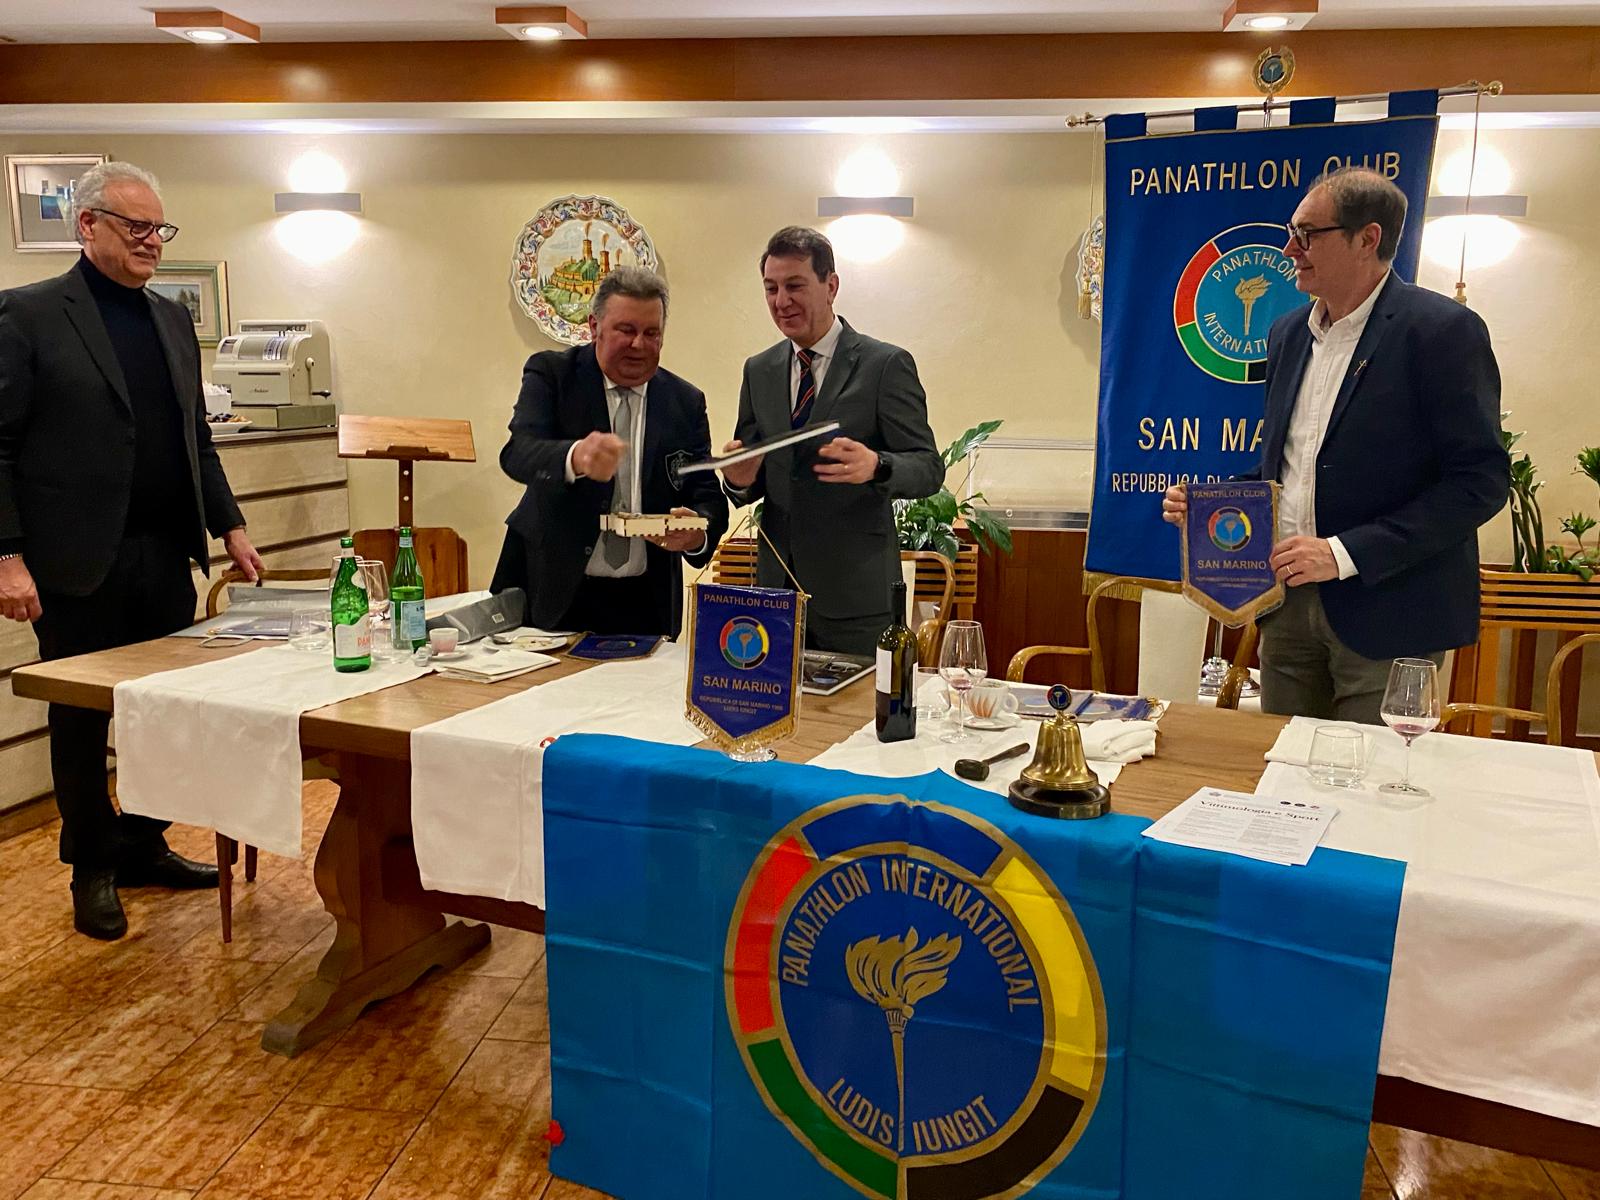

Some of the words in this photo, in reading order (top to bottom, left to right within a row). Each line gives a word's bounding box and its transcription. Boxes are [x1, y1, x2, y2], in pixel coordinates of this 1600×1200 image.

[1129, 157, 1301, 196] PANATHLON
[1211, 251, 1297, 283] PANATHLON
[1203, 312, 1268, 355] INTERNATI
[1138, 417, 1200, 451] SAN
[1192, 489, 1241, 499] PANATHLON
[1243, 489, 1267, 498] CLUB
[1197, 559, 1220, 569] SAN
[1222, 560, 1267, 570] MARINO
[703, 593, 761, 607] PANATHLON
[763, 599, 790, 610] CLUB
[702, 675, 729, 688] SAN
[731, 680, 782, 695] MARINO
[782, 862, 871, 988] PANATHLON
[881, 857, 1040, 1014] INTERNATIONAL
[827, 1077, 896, 1147] LUDIS
[911, 1094, 998, 1153] IUNGIT
